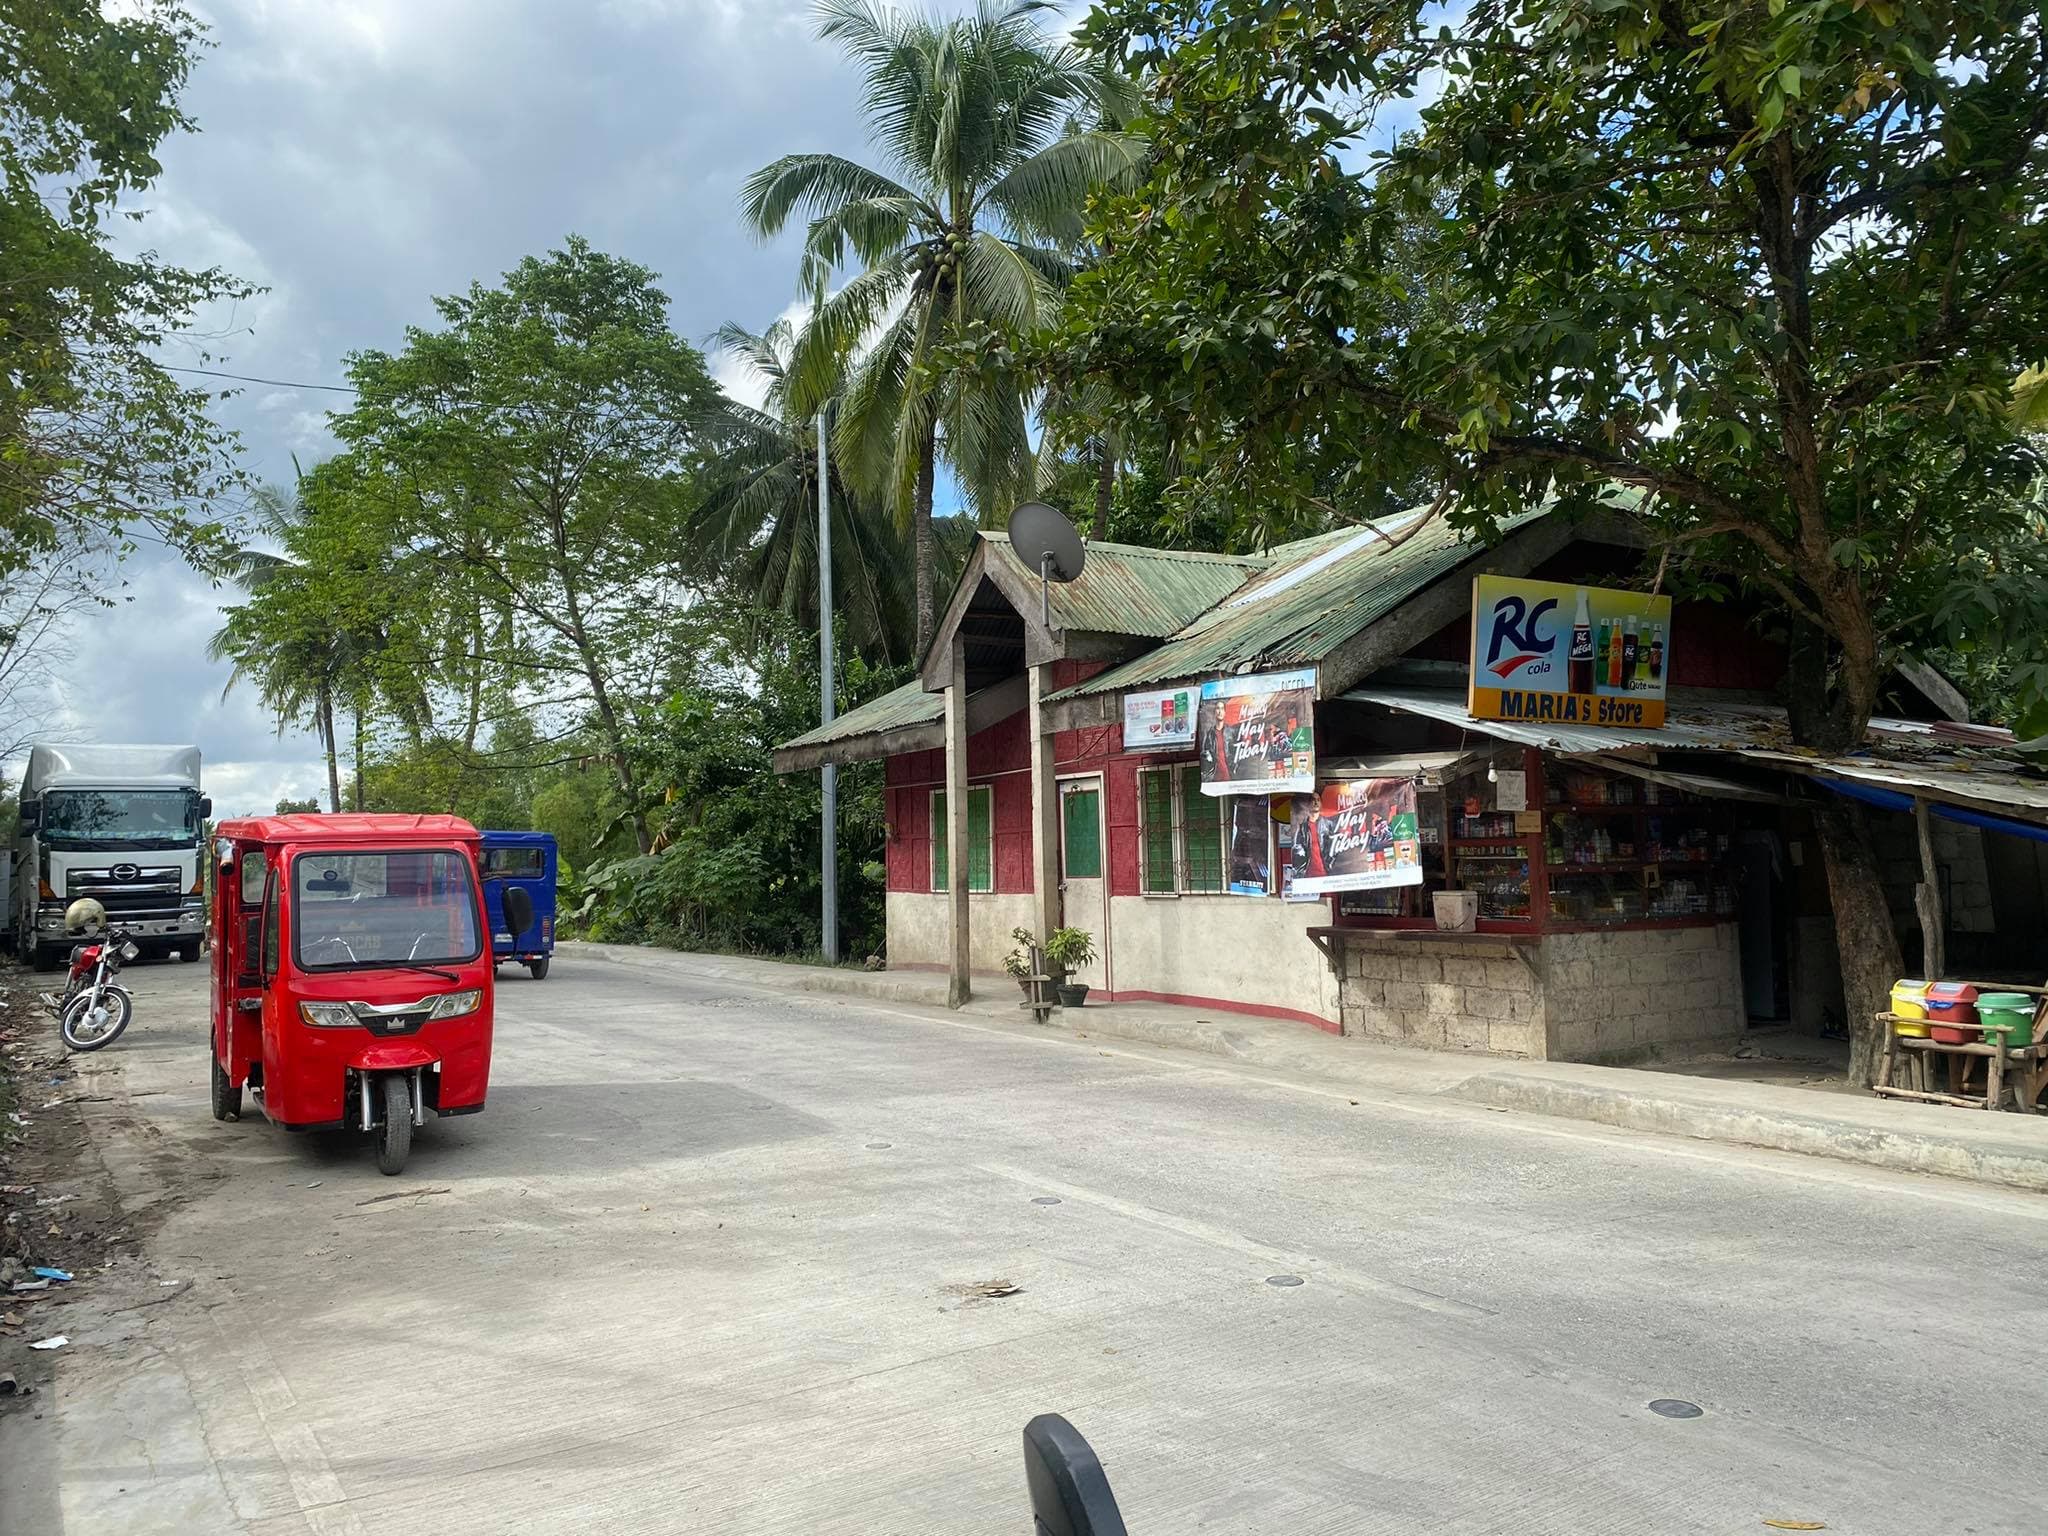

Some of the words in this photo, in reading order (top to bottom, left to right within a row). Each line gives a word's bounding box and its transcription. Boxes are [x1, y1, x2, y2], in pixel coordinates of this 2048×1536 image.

[1486, 596, 1559, 666] RC
[1576, 632, 1587, 643] RC
[1572, 643, 1592, 656] MEGA
[1528, 661, 1551, 675] cola
[1237, 720, 1265, 741] May
[1233, 740, 1269, 764] Tibay
[1334, 810, 1367, 833] May
[1329, 830, 1370, 858] Tibay
